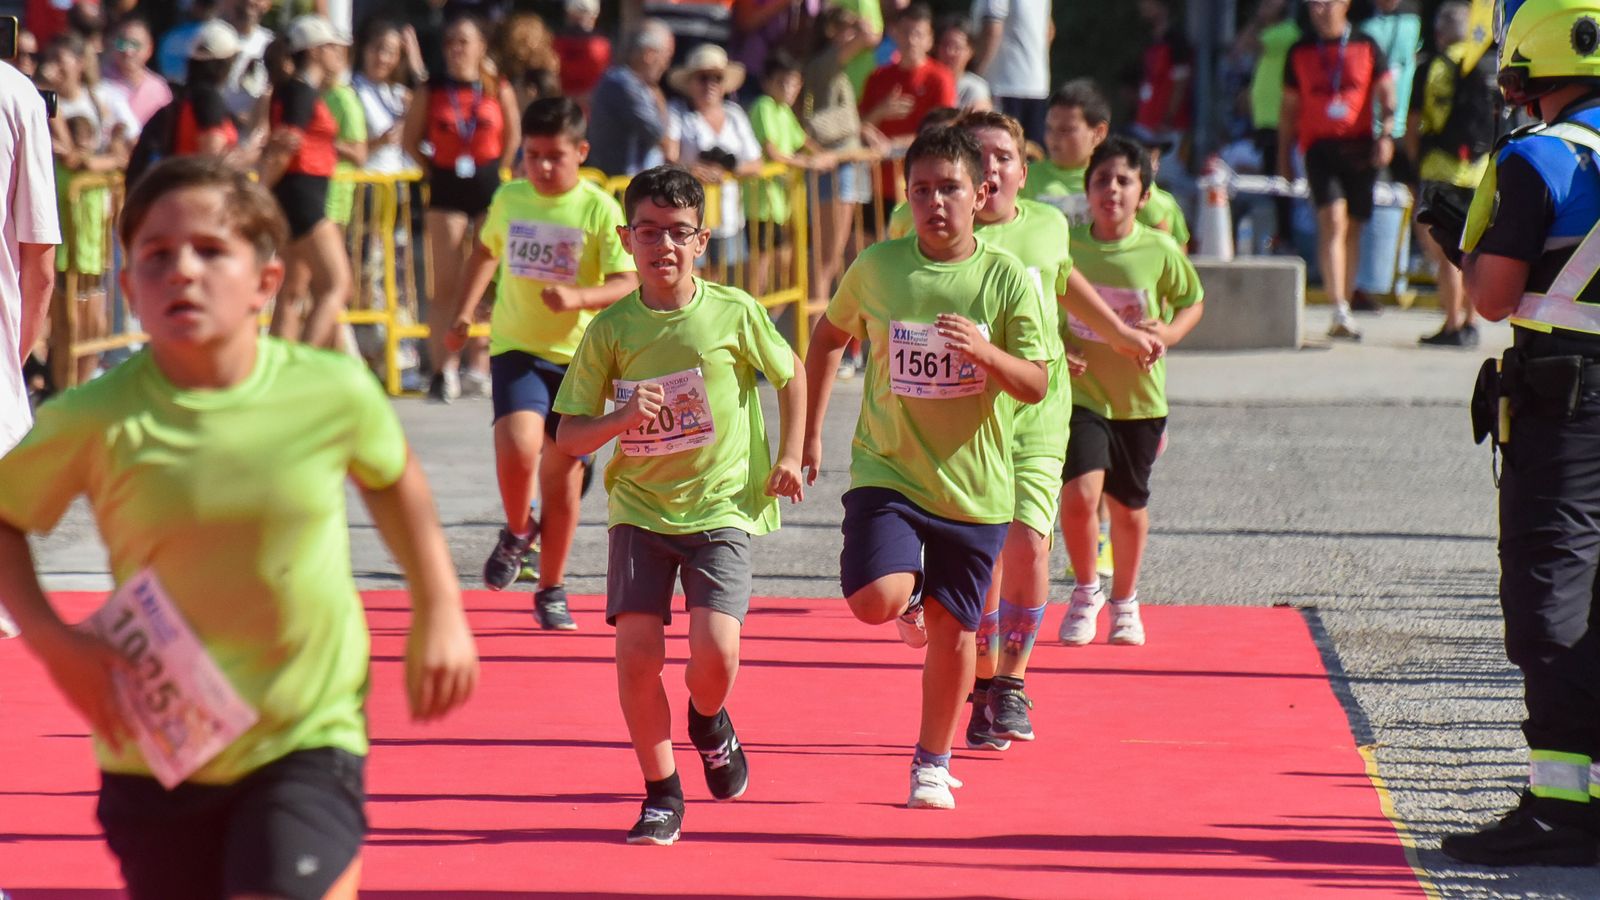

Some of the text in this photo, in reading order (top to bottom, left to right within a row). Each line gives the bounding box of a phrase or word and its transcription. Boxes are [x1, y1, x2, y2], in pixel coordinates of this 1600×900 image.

[510, 241, 553, 265] 1495
[894, 328, 911, 341] XXI
[895, 349, 951, 378] 1561
